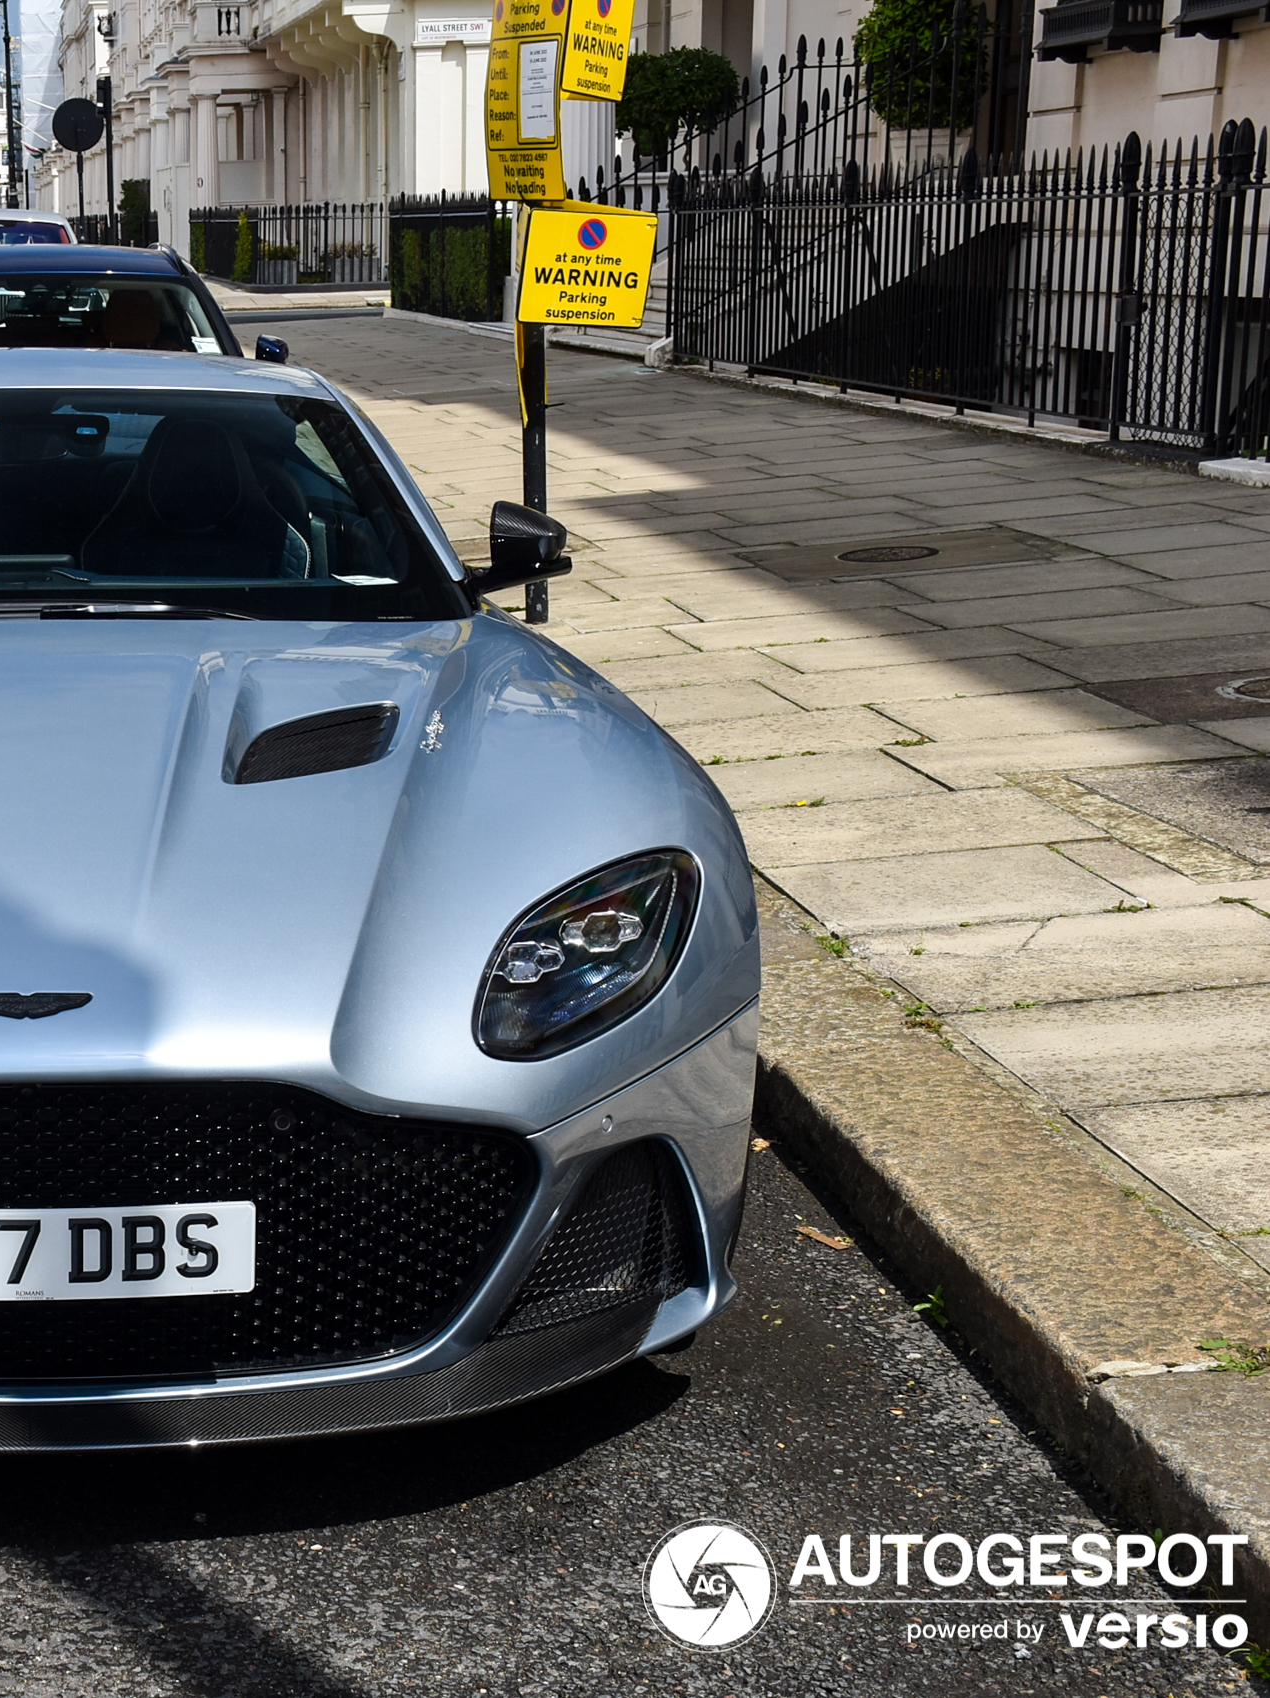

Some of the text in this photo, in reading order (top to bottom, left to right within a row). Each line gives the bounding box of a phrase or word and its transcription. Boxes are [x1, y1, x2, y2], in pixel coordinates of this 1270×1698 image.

[510, 3, 540, 16] Parking
[422, 23, 484, 33] LYALL STREET SW1
[504, 18, 546, 35] Suspended
[585, 20, 618, 36] at any time
[573, 32, 624, 61] WARNING
[493, 48, 510, 60] From:
[491, 69, 508, 80] Until:
[584, 59, 609, 78] Parking
[576, 77, 611, 93] suspension
[490, 89, 510, 101] Place:
[489, 109, 517, 121] Reason:
[490, 129, 504, 142] Ref:
[504, 164, 545, 179] No waiting
[505, 181, 516, 194] No
[555, 252, 622, 266] at any time
[534, 267, 639, 289] WARNING
[559, 291, 607, 307] Parking
[545, 308, 615, 321] suspension
[68, 1213, 219, 1285] DBS
